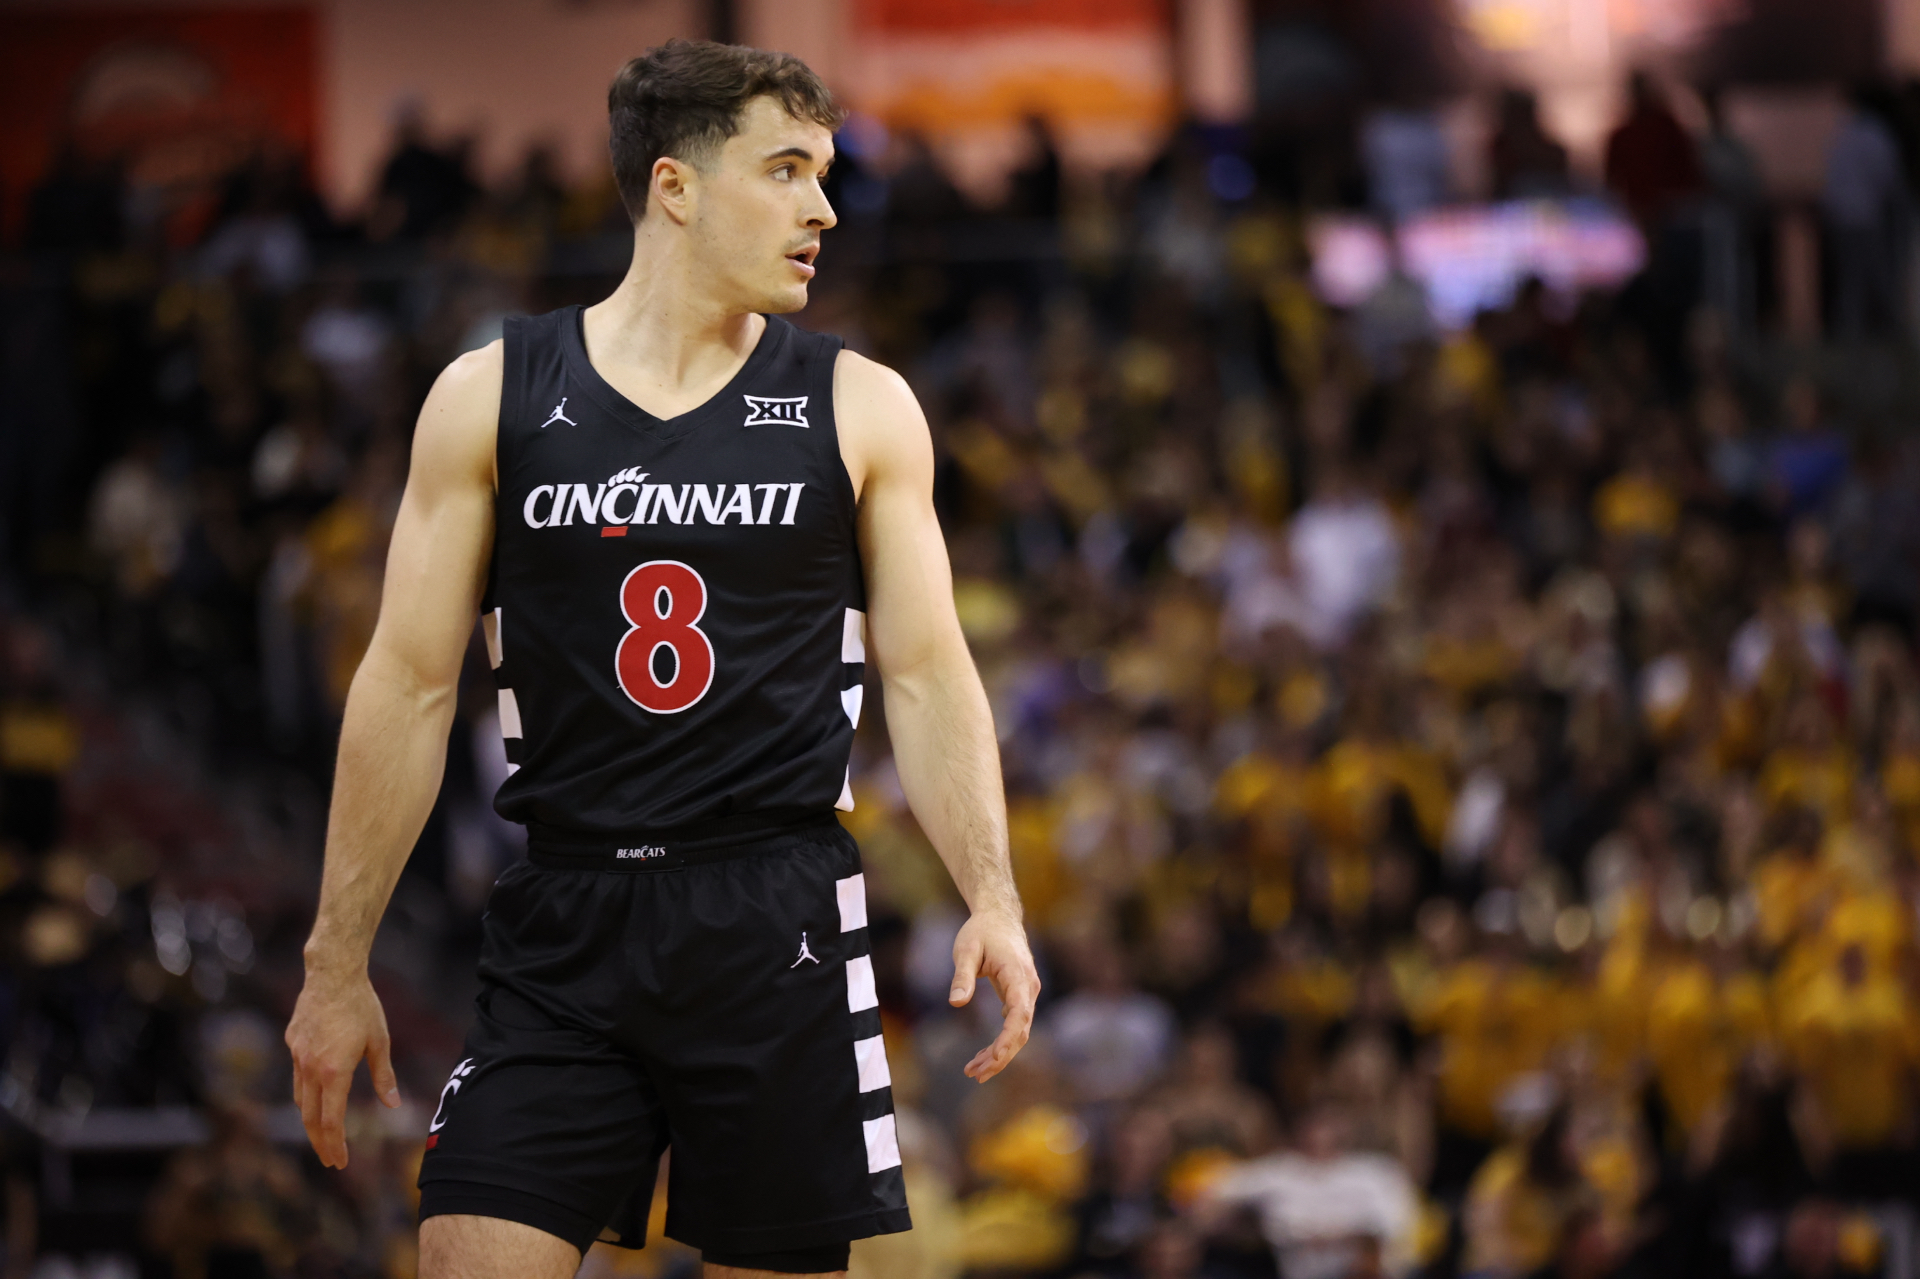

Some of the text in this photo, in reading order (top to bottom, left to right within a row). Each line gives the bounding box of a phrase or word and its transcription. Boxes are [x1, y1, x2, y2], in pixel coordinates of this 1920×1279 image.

[524, 480, 806, 530] CINCINNATI
[614, 560, 715, 715] 8
[616, 846, 667, 859] BEARCATS
